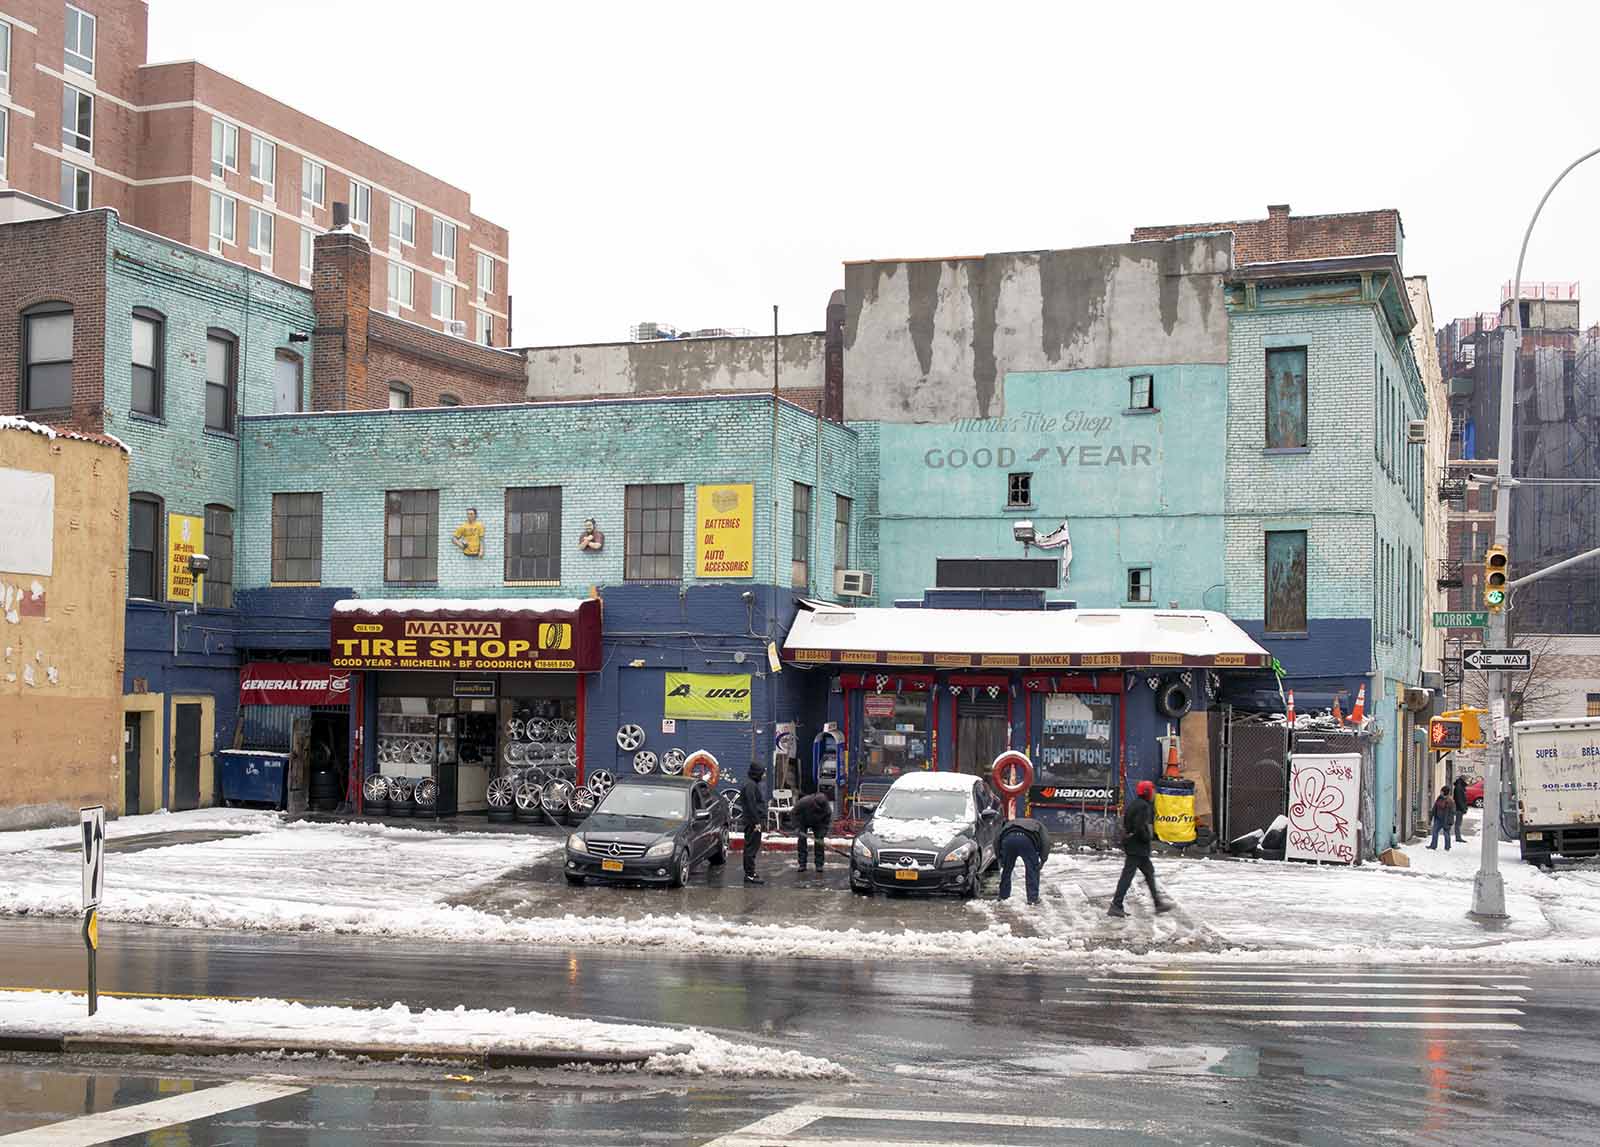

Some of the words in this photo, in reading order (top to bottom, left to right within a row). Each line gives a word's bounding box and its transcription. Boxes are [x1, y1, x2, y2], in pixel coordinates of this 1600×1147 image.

[1062, 409, 1113, 437] Shop
[924, 448, 1016, 469] GOOD
[1056, 446, 1151, 467] YEAR
[704, 518, 740, 528] BATTERIES
[704, 534, 714, 545] OIL
[704, 550, 724, 560] AUTO
[704, 561, 749, 572] ACCESSORIES
[1435, 613, 1472, 626] MORRIS
[407, 623, 498, 635] MARWA
[337, 639, 418, 657] TIRE
[429, 640, 530, 658] SHOP
[365, 659, 391, 667] YEAR
[459, 660, 472, 668] BF
[475, 660, 532, 668] GOODRICH
[1472, 655, 1492, 664] ONE
[1503, 655, 1524, 664] WAY
[242, 680, 299, 690] GENERAL
[300, 680, 329, 690] TIRE
[1043, 748, 1111, 764] ARMSTRONG
[1536, 749, 1558, 758] SUPER
